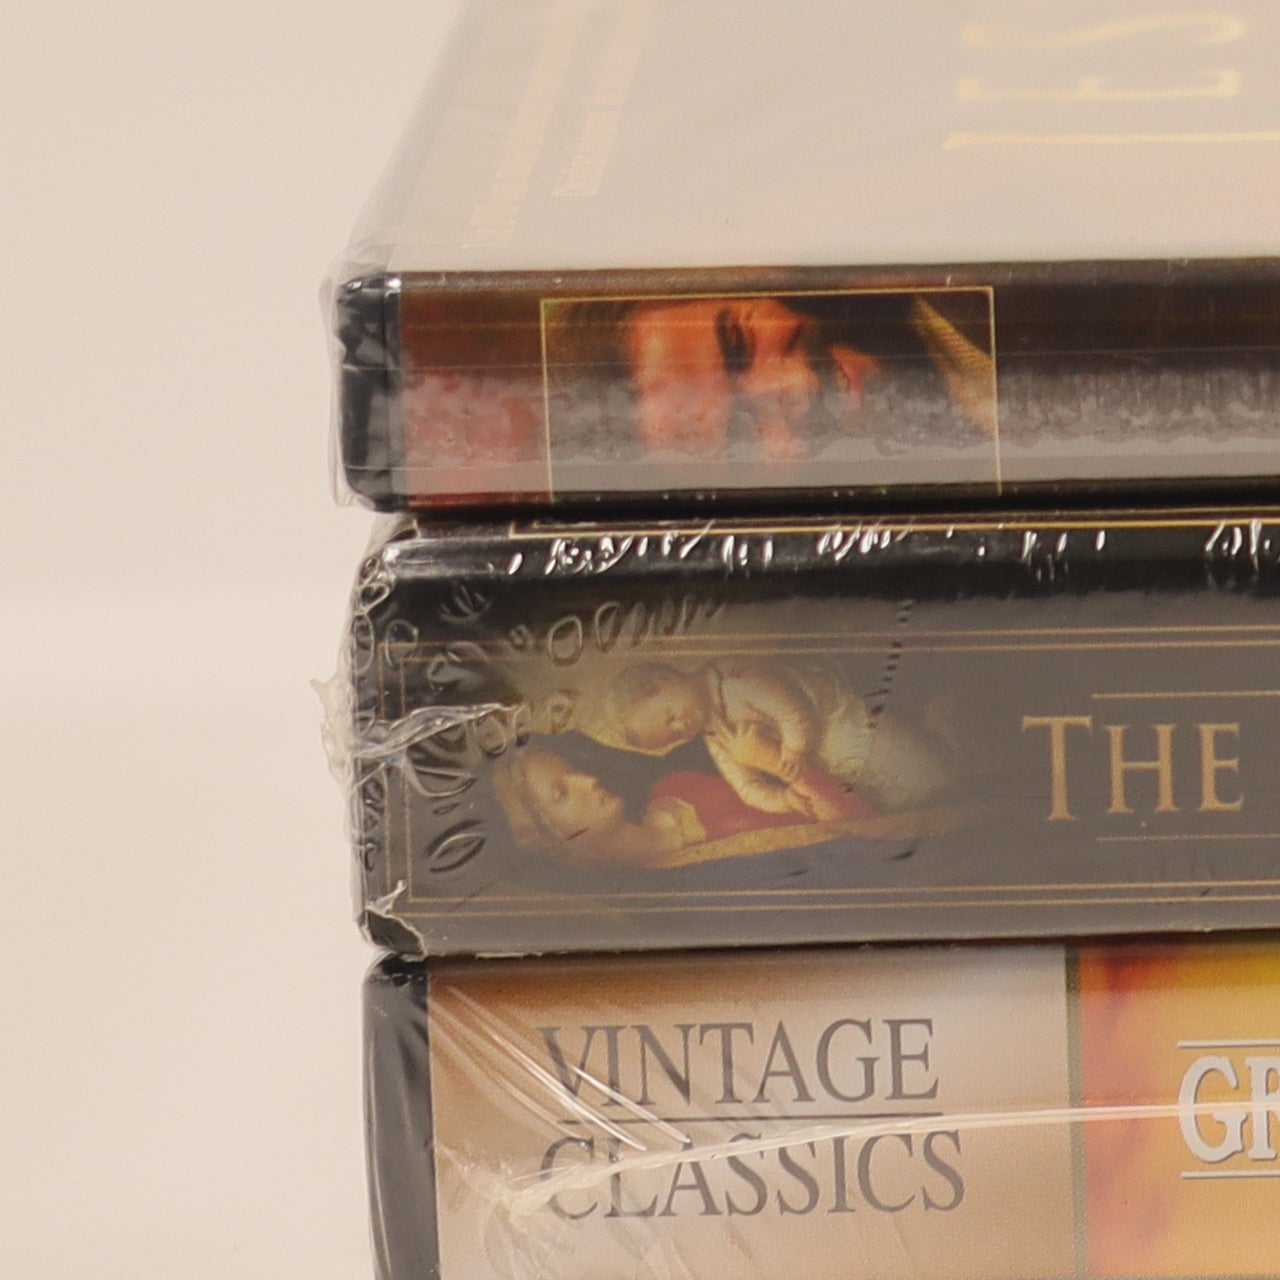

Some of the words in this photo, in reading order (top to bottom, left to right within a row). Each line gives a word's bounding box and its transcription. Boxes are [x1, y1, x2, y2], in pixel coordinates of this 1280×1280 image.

[1022, 713, 1245, 822] THE
[536, 1018, 940, 1108] VINTAGE
[539, 1128, 967, 1220] CLASSICS
